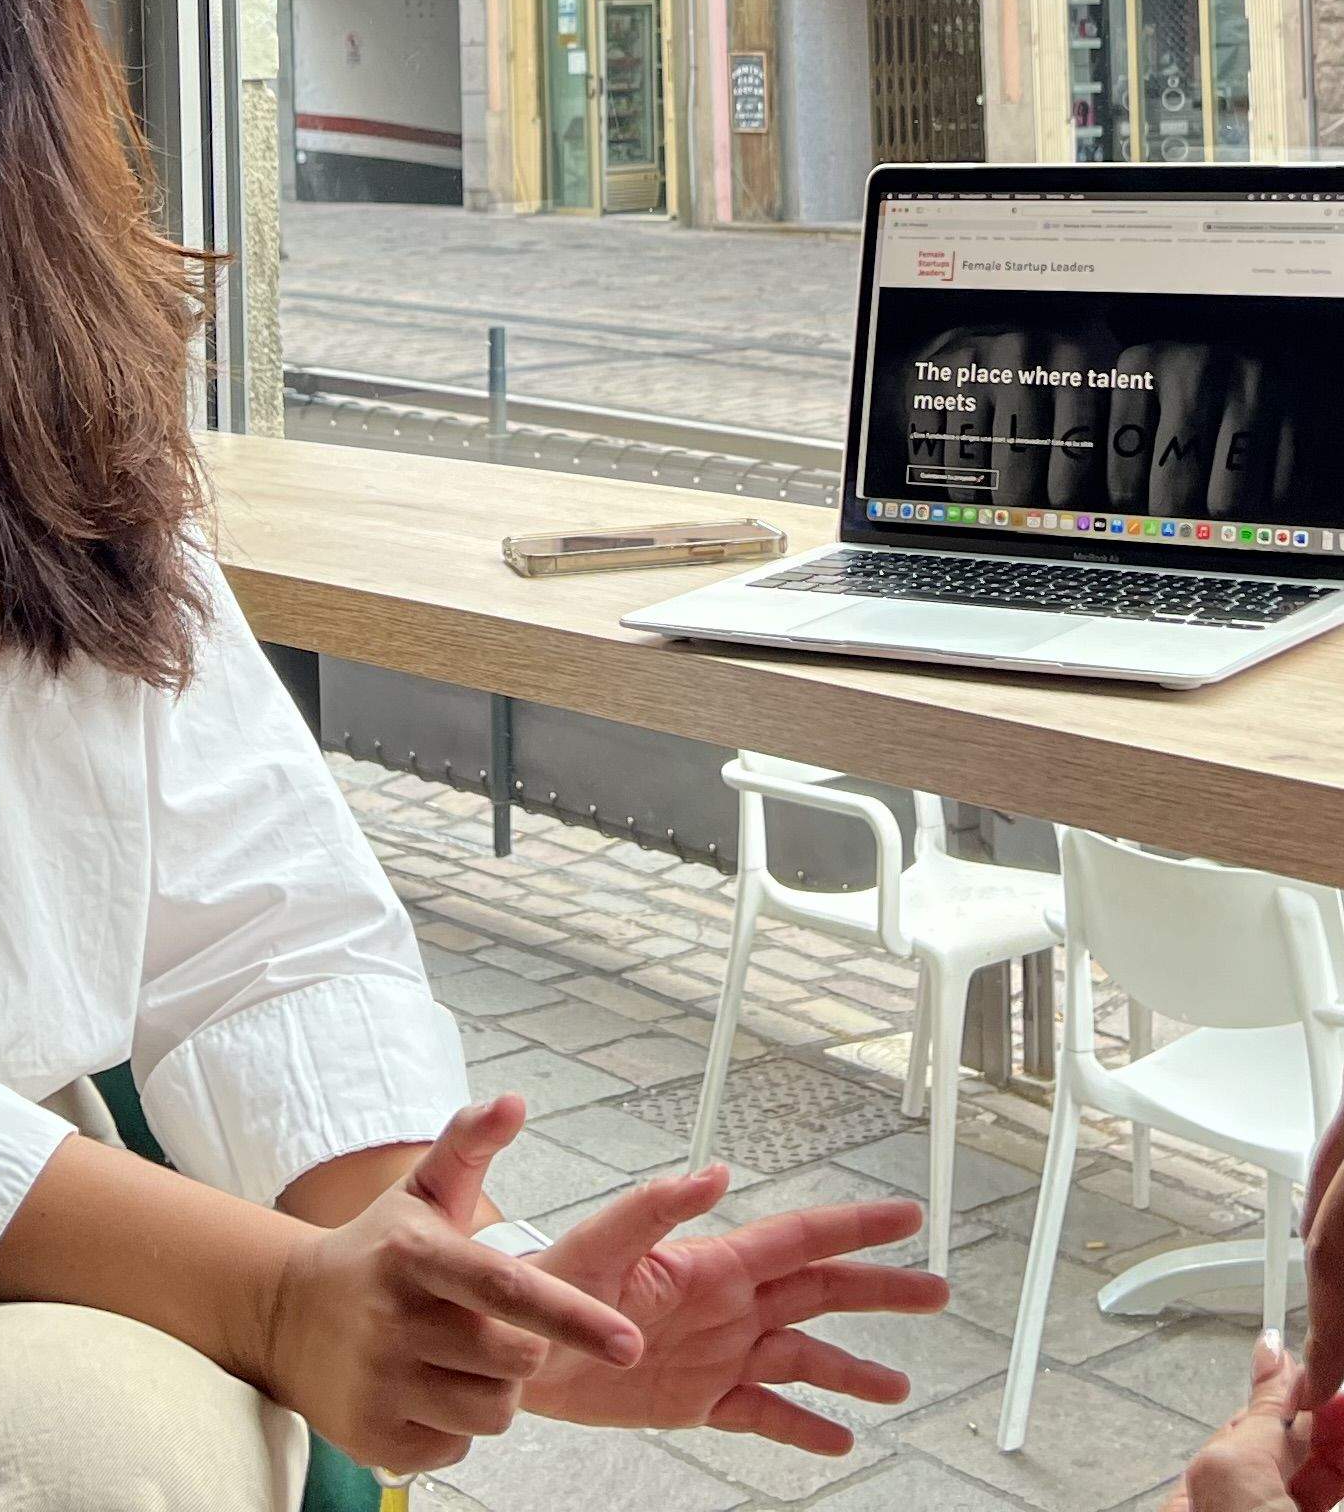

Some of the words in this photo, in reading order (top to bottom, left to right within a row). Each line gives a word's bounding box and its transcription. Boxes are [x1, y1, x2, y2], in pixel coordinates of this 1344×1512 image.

[918, 250, 945, 258] Female
[962, 260, 1002, 271] Female
[1004, 261, 1048, 274] Startup
[1050, 262, 1095, 273] Leaders
[915, 361, 952, 382] The
[956, 363, 1013, 388] place
[1018, 366, 1082, 387] where
[1087, 368, 1154, 390] talent
[913, 393, 977, 412] meets
